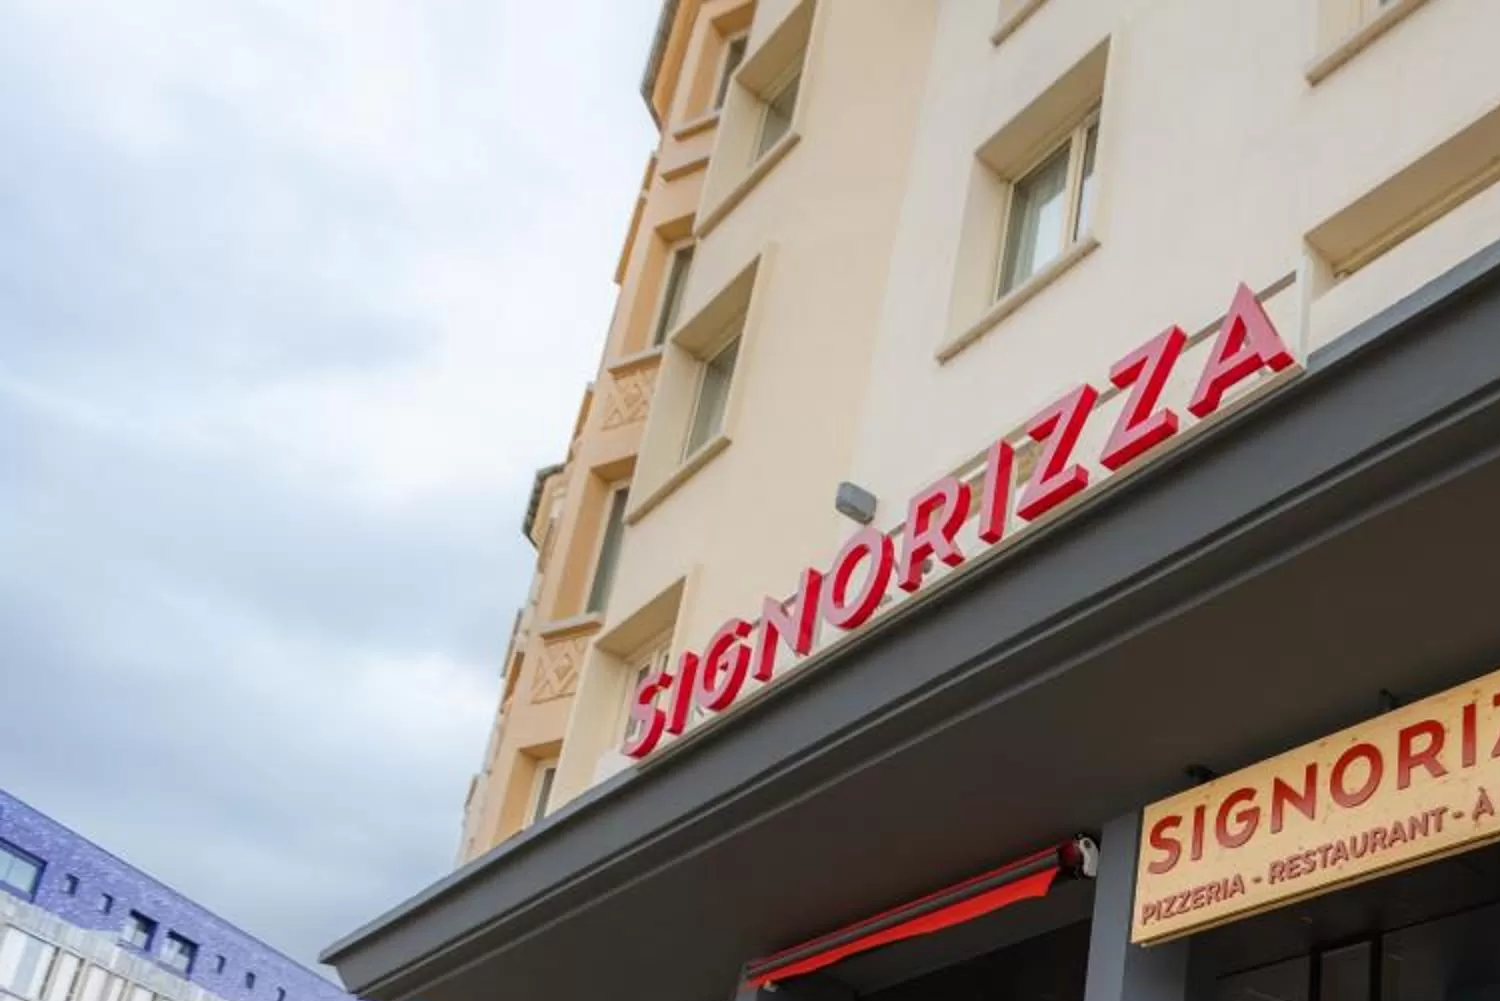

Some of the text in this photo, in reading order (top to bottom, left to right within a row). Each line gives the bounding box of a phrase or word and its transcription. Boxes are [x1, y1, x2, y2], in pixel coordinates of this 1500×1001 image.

[621, 281, 1296, 758] SIGNORIZZA
[1141, 873, 1246, 926] PIZZERIA
[1267, 806, 1449, 885] RESTAURANT
[1471, 785, 1495, 821] À
